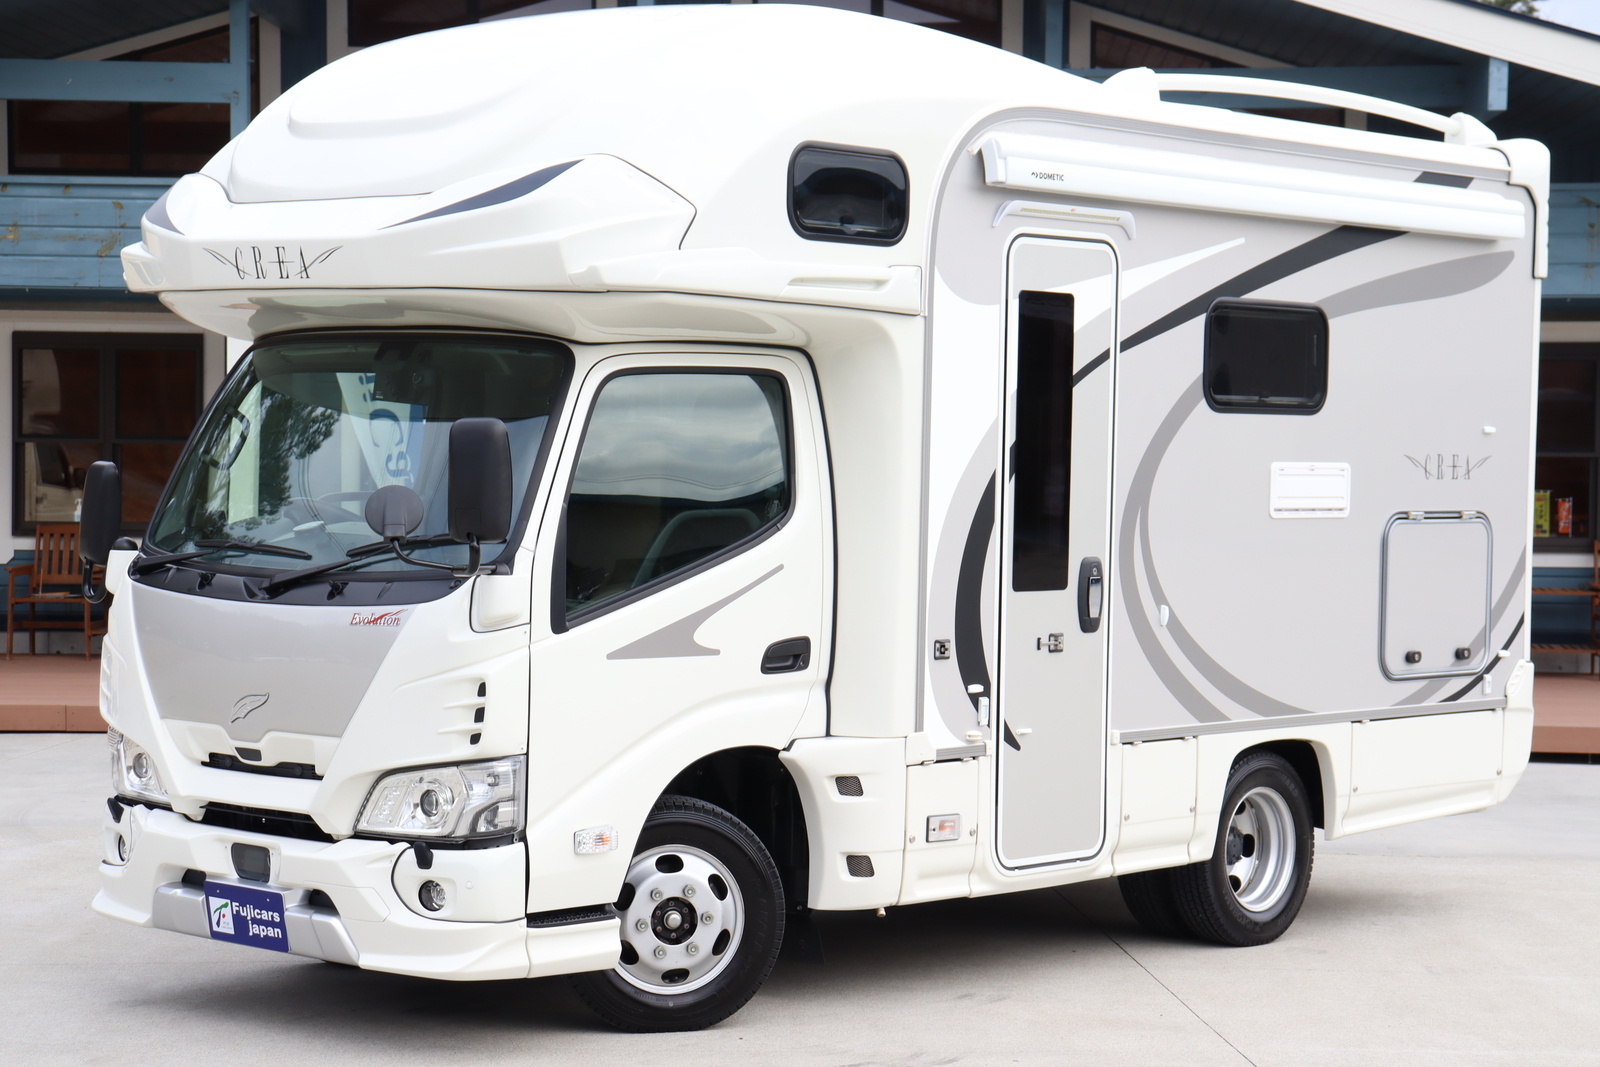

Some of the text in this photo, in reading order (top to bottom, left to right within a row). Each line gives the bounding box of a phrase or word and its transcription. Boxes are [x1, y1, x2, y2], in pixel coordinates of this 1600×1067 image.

[1039, 172, 1065, 181] DOMETIC
[234, 245, 310, 280] CREA
[1424, 453, 1471, 480] CREA
[349, 612, 402, 626] Evolution
[232, 901, 281, 923] Fujicars
[248, 920, 283, 938] japan
